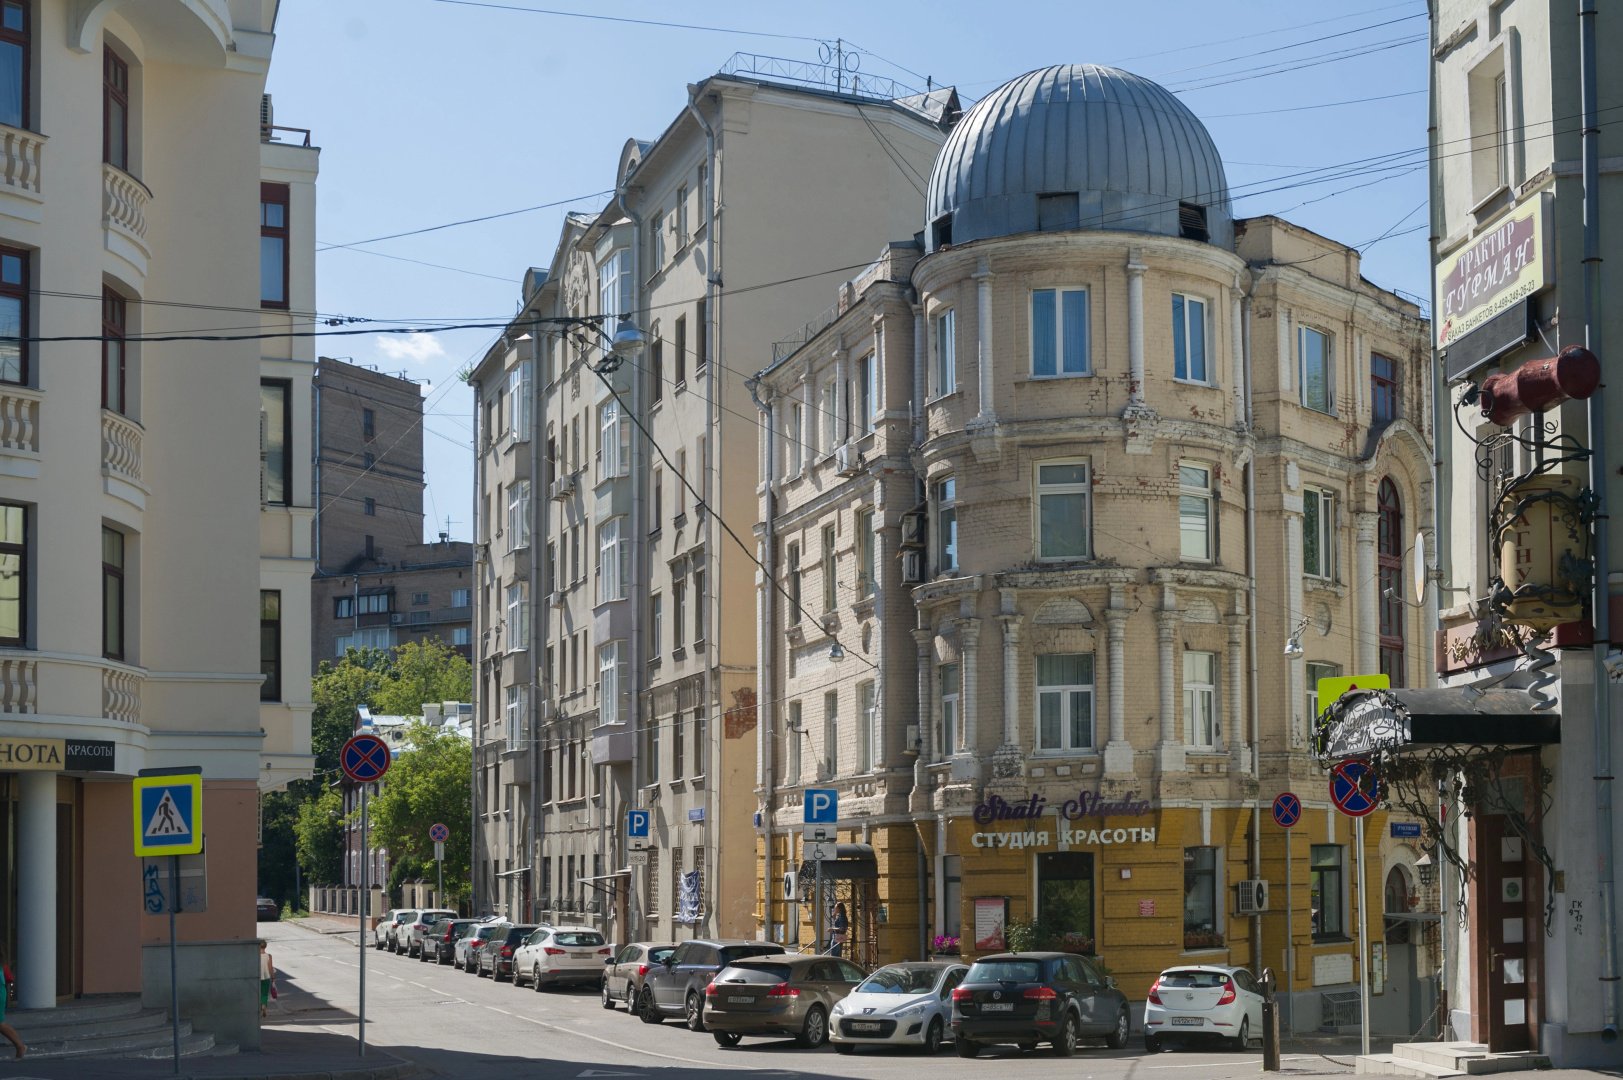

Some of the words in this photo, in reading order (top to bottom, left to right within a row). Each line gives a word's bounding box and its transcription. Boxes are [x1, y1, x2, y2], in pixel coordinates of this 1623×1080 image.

[1458, 221, 1515, 278] ТРАКТИР
[1446, 237, 1530, 316] ГУРМАН
[1447, 323, 1464, 341] ЗАКАЗ
[1465, 305, 1494, 331] БАНКЕТОВ
[1512, 493, 1533, 595] МАГНУ
[67, 745, 113, 757] КРАСОТЫ
[1062, 790, 1150, 821] Studio
[971, 831, 1049, 850] СТУДИЯ
[1062, 827, 1156, 845] КРАСОТЫ
